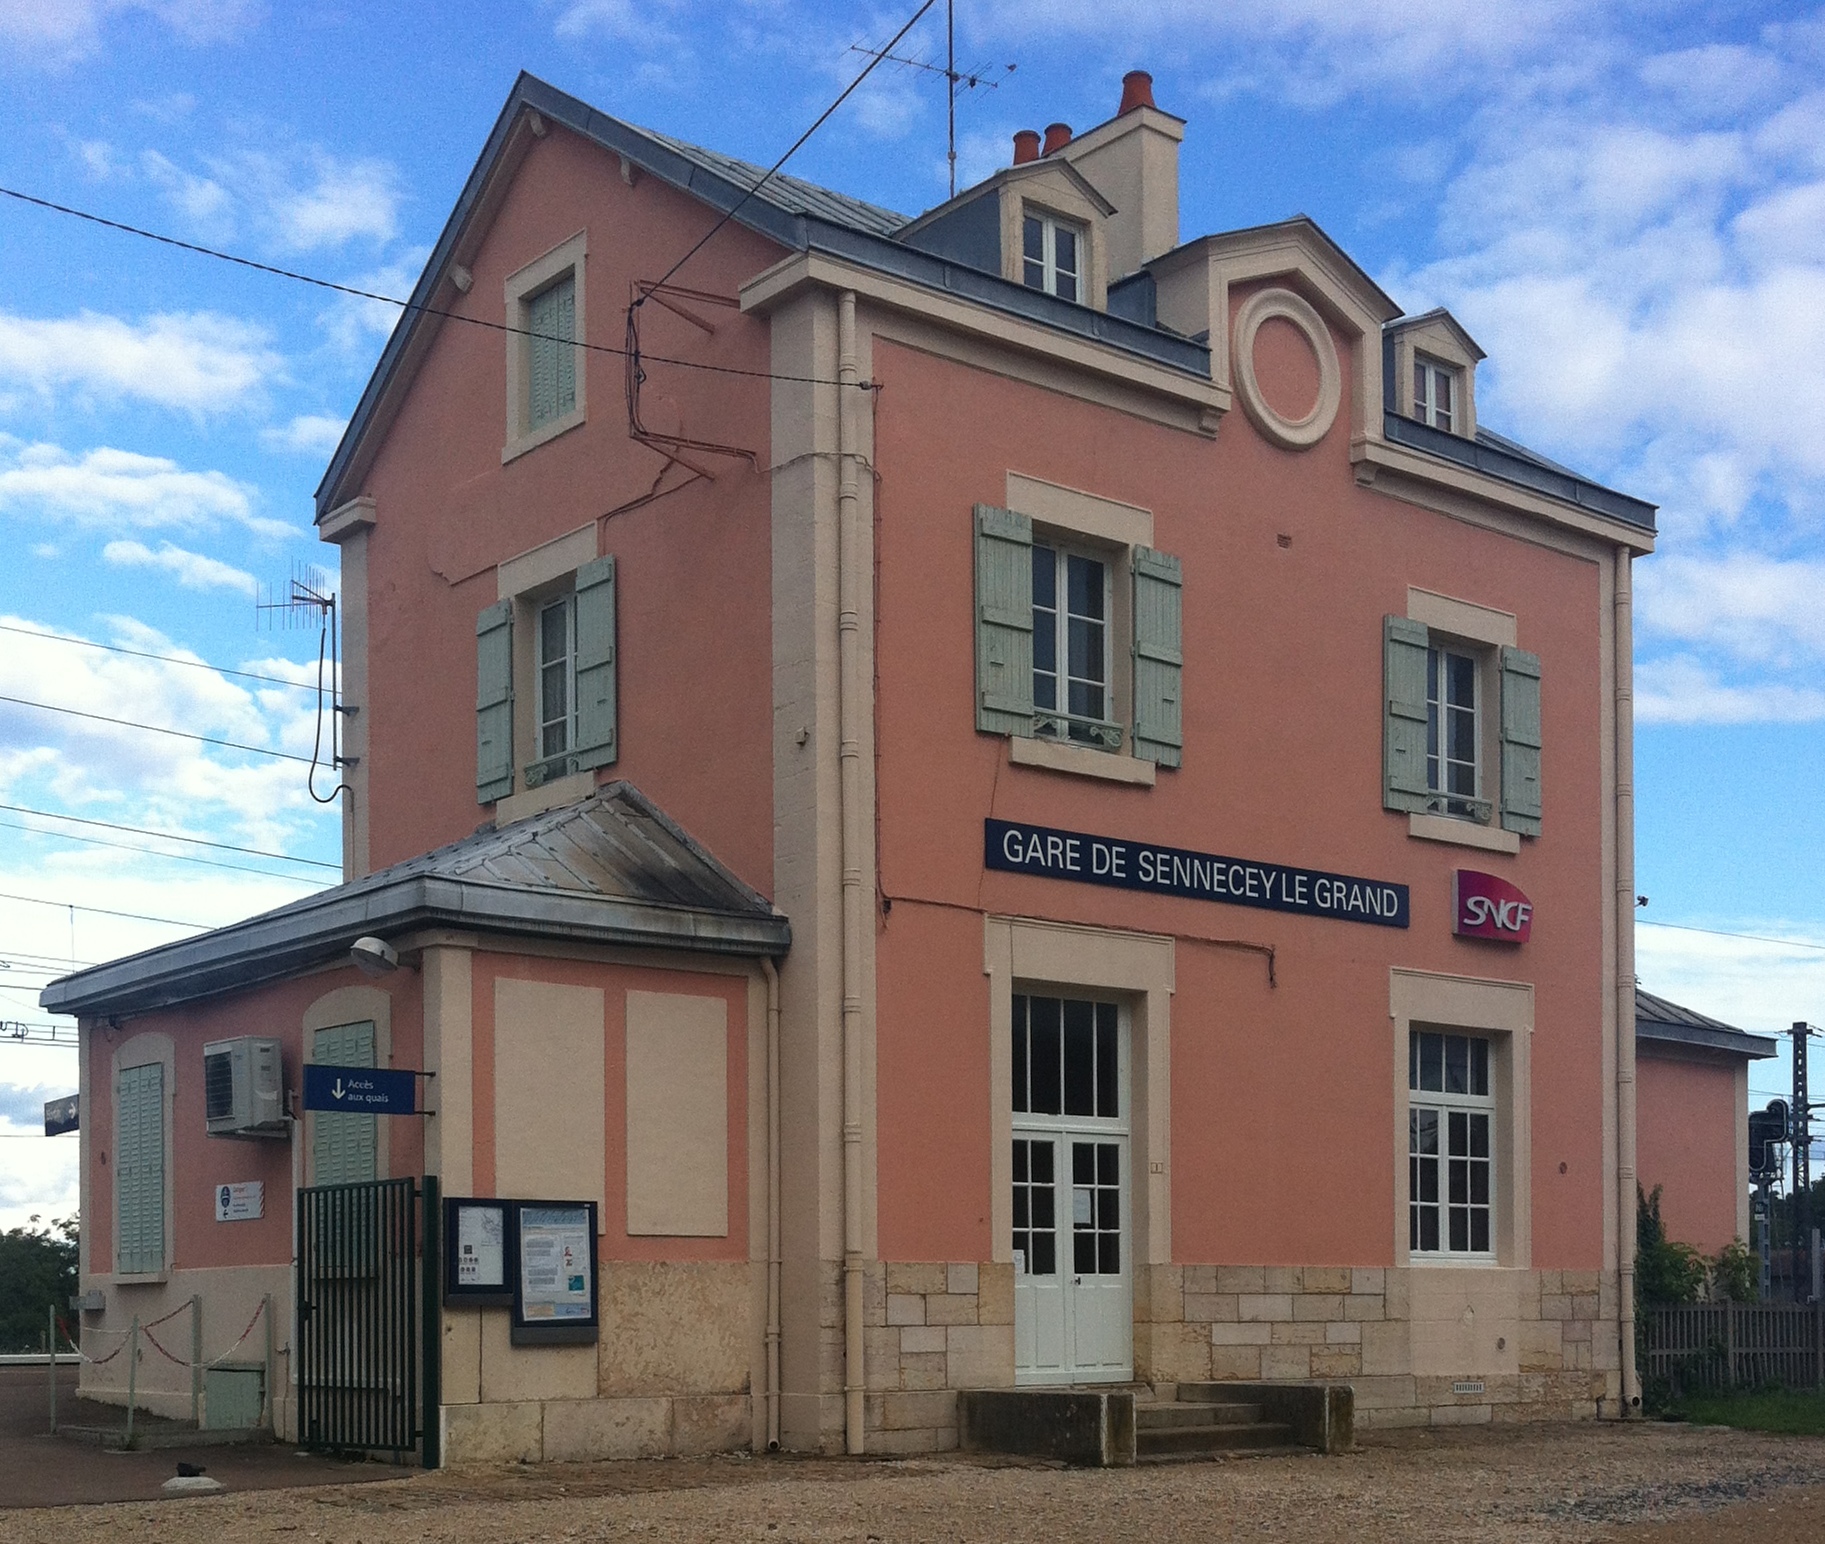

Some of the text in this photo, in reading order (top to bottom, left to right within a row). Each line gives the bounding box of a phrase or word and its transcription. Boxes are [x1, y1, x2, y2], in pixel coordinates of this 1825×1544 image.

[1003, 829, 1399, 917] GARE DE SENNECEY LE GRAND
[1463, 896, 1532, 931] SNCF
[347, 1079, 374, 1090] Accès
[347, 1092, 389, 1104] aux quais
